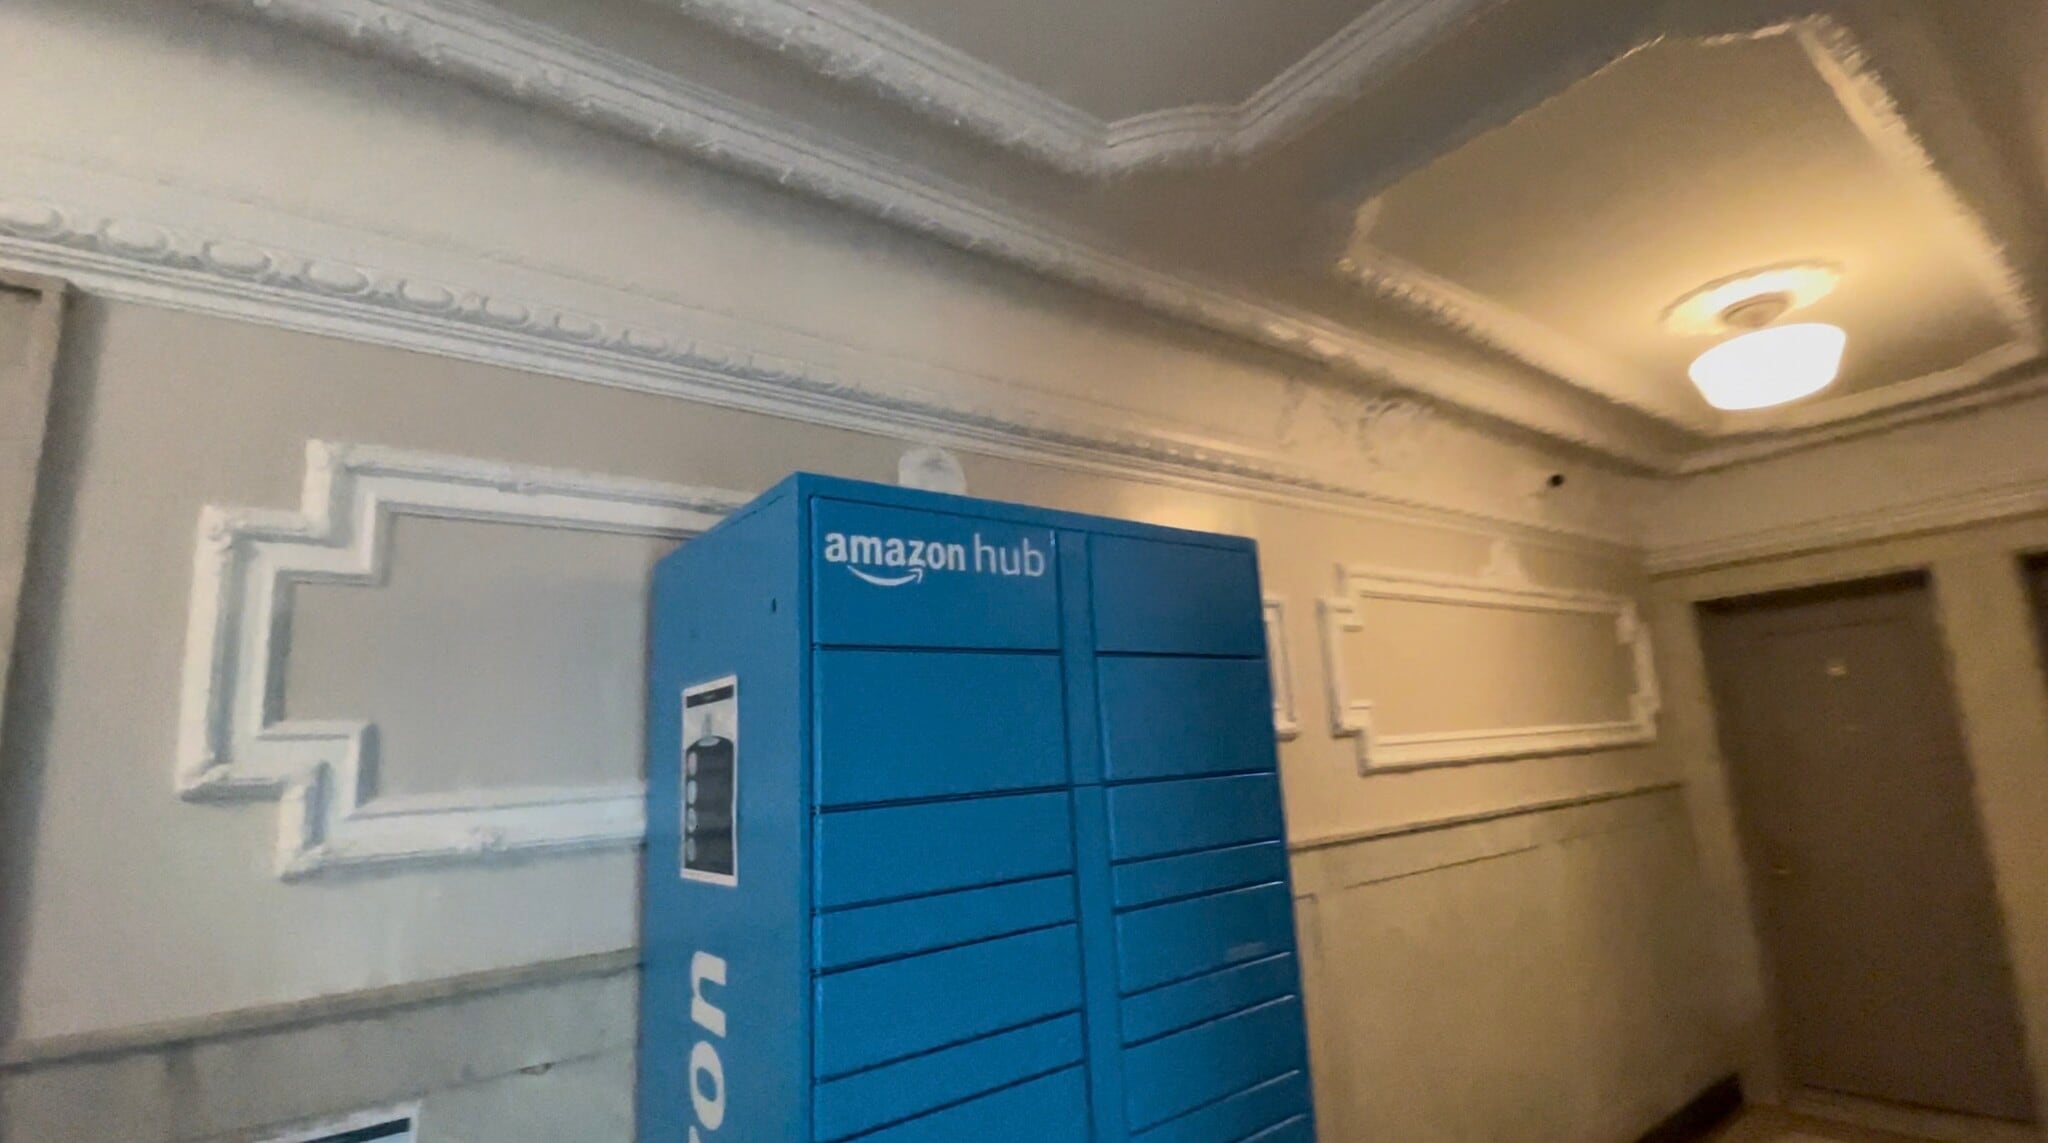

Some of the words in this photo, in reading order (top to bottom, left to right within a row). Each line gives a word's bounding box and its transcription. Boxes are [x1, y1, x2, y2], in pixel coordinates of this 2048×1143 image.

[825, 532, 966, 573] amazon
[973, 532, 1045, 577] hub
[689, 950, 727, 1143] on
